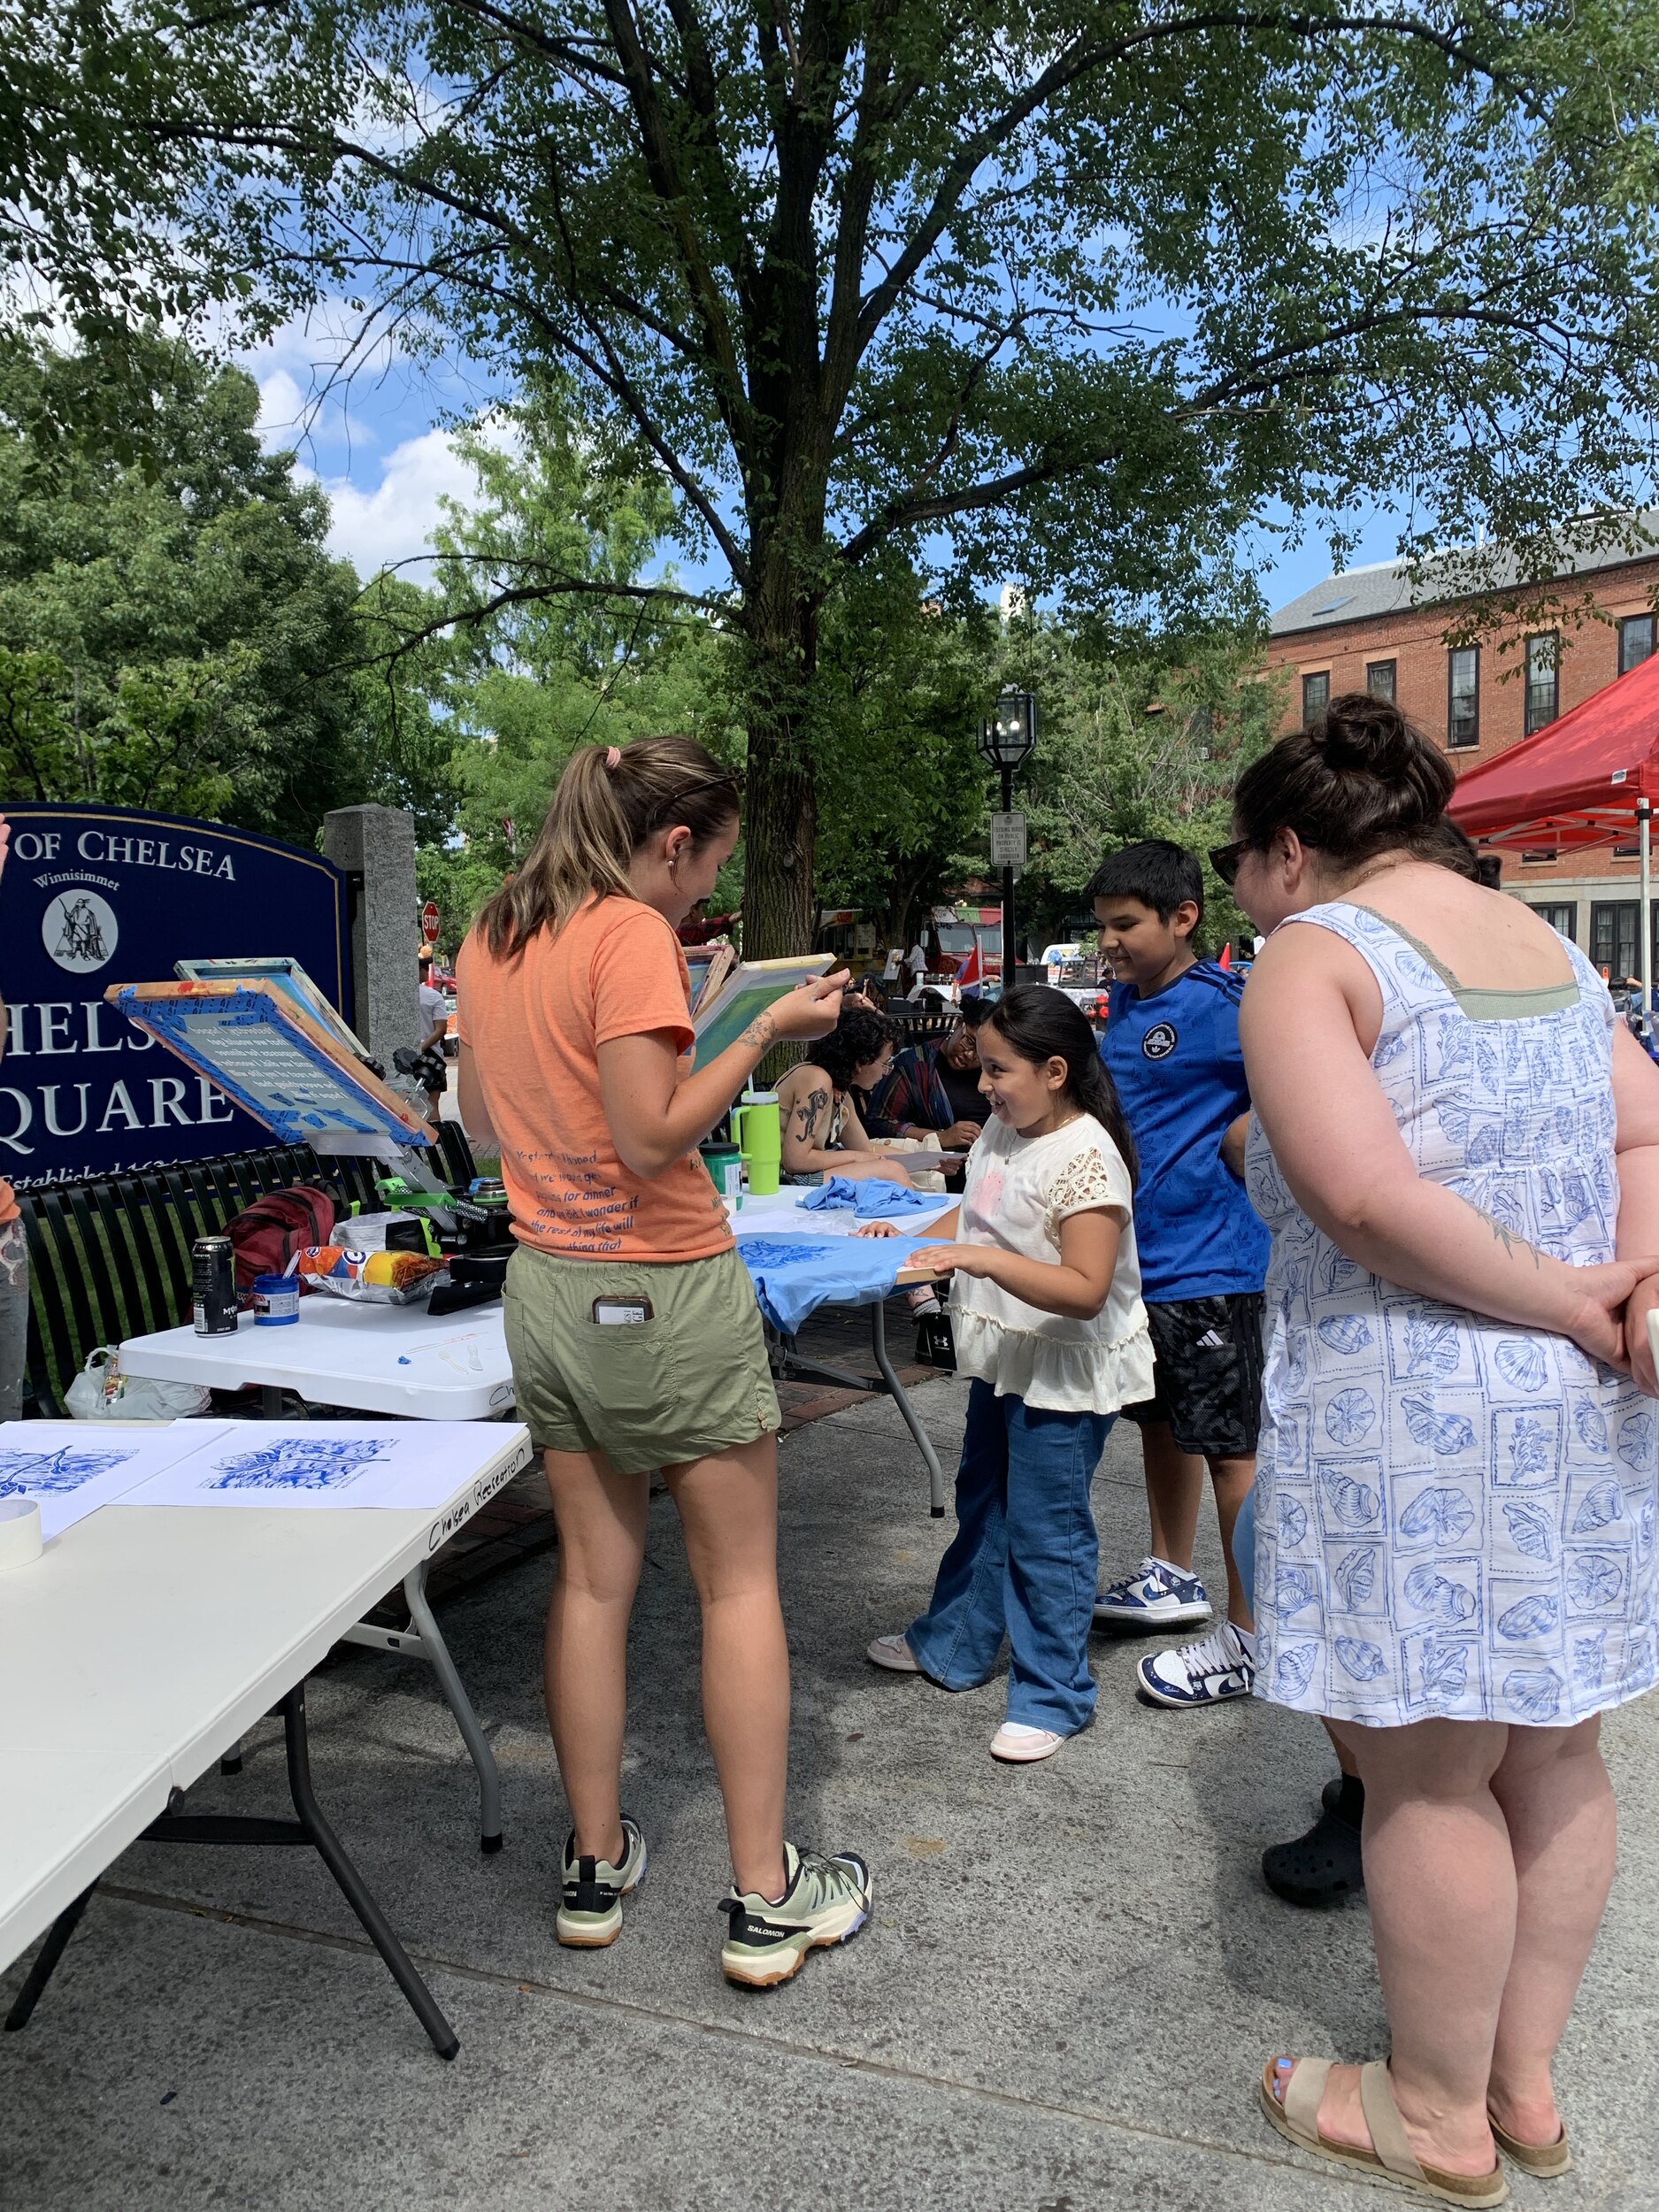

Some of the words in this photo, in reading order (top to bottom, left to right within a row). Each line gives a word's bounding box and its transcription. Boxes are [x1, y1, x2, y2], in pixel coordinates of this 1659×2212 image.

[14, 833, 61, 860] OF
[77, 831, 236, 881] CHELSEA
[33, 868, 120, 891] Winnisimmet
[425, 915, 439, 930] STOP
[0, 1076, 234, 1155] QUARE
[531, 1219, 546, 1233] the
[613, 1216, 634, 1230] will
[597, 1239, 621, 1252] that
[428, 1502, 471, 1552] Chelsea
[747, 1924, 786, 1938] SALOMON
